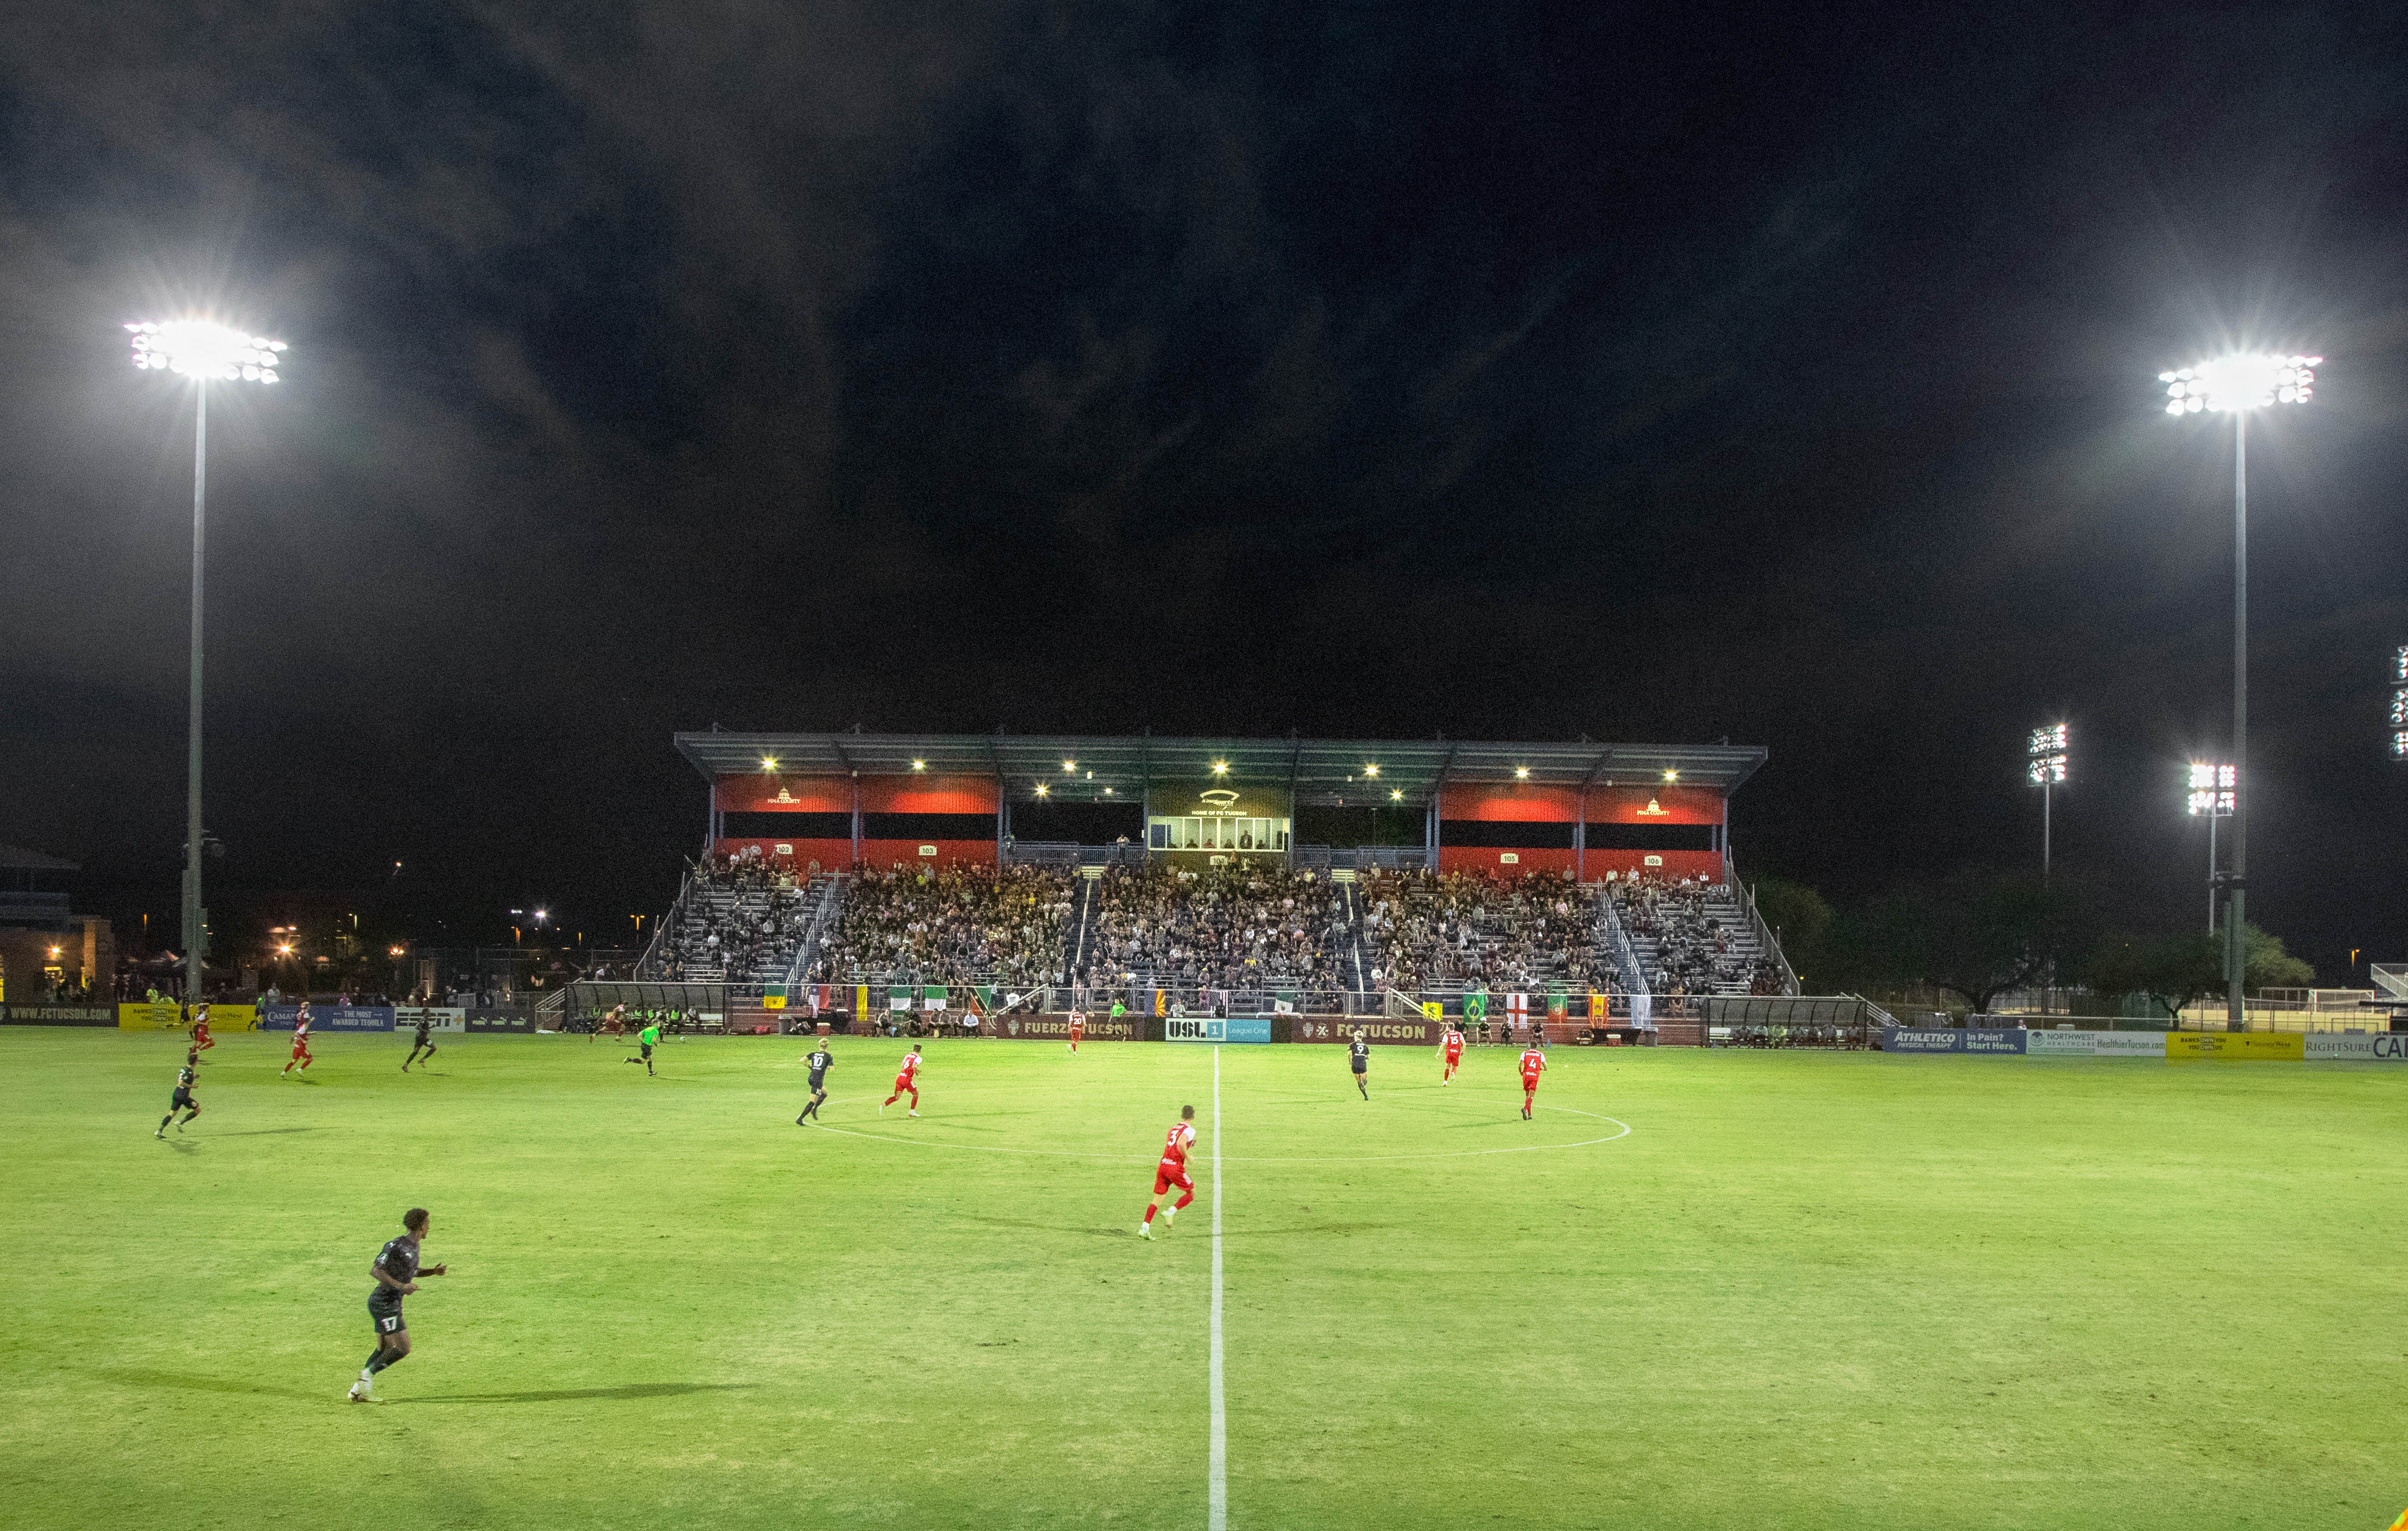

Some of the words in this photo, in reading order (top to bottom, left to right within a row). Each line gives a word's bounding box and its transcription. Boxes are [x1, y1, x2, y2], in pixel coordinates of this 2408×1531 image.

[11, 1007, 111, 1020] WWW.FCTUCSON.COM
[1025, 1022, 1070, 1035] FUERZ
[1169, 1021, 1206, 1038] USL
[1228, 1027, 1251, 1036] League
[1337, 1023, 1355, 1037] FC
[1362, 1025, 1425, 1039] TUCSON
[1450, 1036, 1459, 1045] 15
[1978, 1033, 2004, 1041] Pain?
[1357, 1045, 1364, 1054] 9
[2097, 1039, 2166, 1050] HealthierTucson.com
[2373, 1037, 2408, 1057] CA
[813, 1056, 823, 1067] 10
[1528, 1058, 1536, 1069] 4
[1167, 1130, 1179, 1146] 3
[382, 1315, 398, 1331] 17
